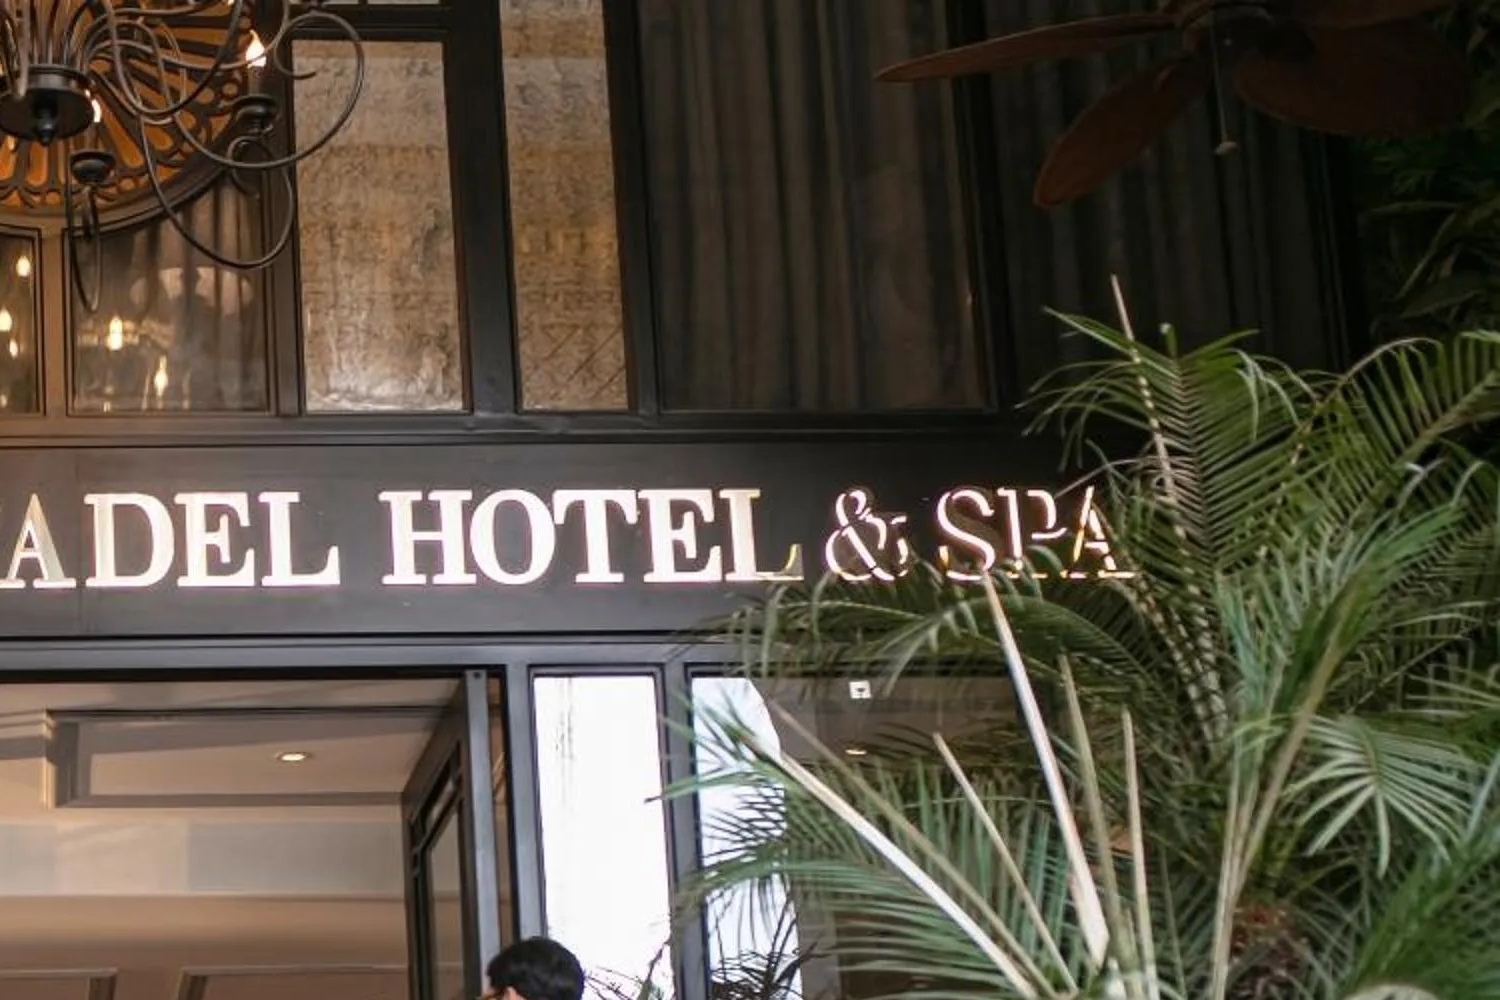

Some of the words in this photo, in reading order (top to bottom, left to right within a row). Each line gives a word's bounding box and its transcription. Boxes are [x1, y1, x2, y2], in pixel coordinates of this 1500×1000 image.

[379, 488, 803, 586] HOTEL
[824, 488, 911, 584] &
[935, 485, 1142, 581] SPA
